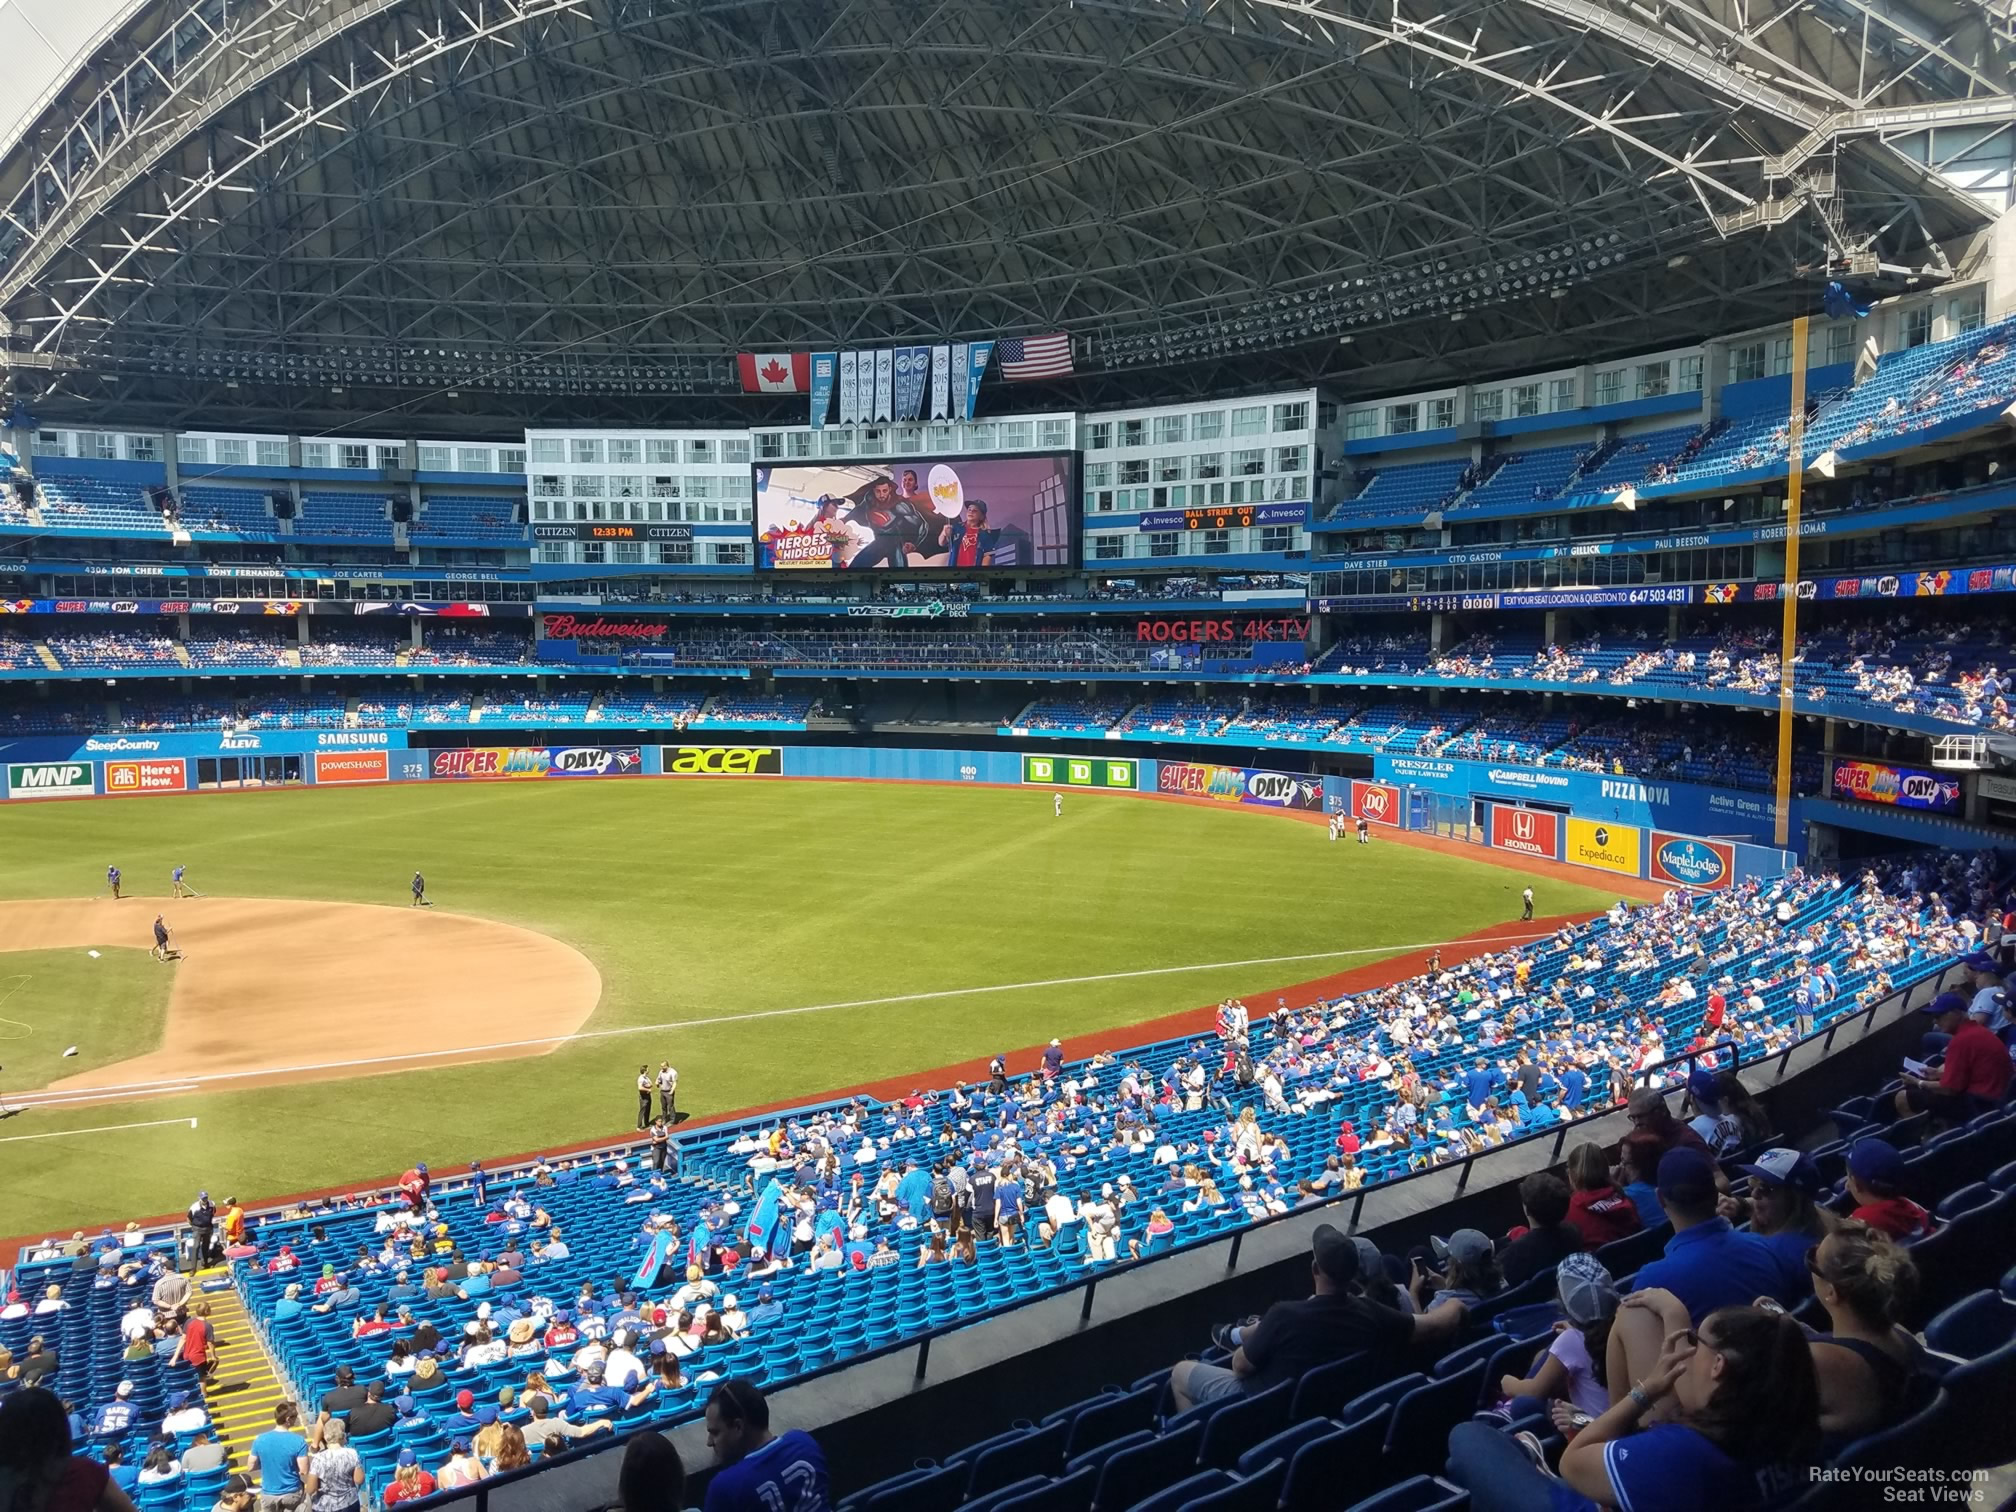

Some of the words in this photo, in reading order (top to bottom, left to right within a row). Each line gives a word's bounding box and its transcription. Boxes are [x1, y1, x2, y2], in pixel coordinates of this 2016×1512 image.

[878, 376, 890, 386] 1991
[934, 373, 948, 384] 2015
[1185, 510, 1204, 518] BALL
[1207, 508, 1233, 516] STRIKE
[1237, 507, 1254, 515] OUT
[1271, 508, 1305, 517] Invesco
[1153, 516, 1183, 525] Invesco
[1190, 518, 1198, 529] 0
[1216, 517, 1224, 528] 0
[1242, 515, 1250, 526] 0
[534, 527, 576, 537] CITIZEN
[593, 527, 616, 537] 12:33
[618, 527, 633, 537] PM
[649, 528, 690, 538] CITIZEN
[1761, 527, 1793, 539] ROBERTO
[1796, 522, 1826, 536] ALOMAR
[776, 533, 827, 550] HEROES
[1655, 540, 1672, 549] PAUL
[1675, 536, 1709, 547] BEESTON
[783, 545, 833, 560] HIDEOUT
[1571, 545, 1600, 555] GILLICK
[1366, 560, 1388, 568] STIEB
[1449, 555, 1466, 563] CITO
[1470, 553, 1501, 562] GASTON
[85, 567, 107, 575] 4306
[111, 567, 131, 575] TOM
[134, 567, 163, 575] CHEEK
[236, 569, 285, 577] FERNANDEZ
[1503, 596, 1517, 605] TEXT
[1517, 596, 1534, 605] YOUR
[1534, 595, 1549, 604] SEAT
[1549, 594, 1578, 604] LOCATION
[1585, 592, 1617, 604] QUESTION
[1617, 592, 1627, 601] TO
[1629, 590, 1648, 602] 647
[1650, 590, 1665, 601] 503
[1666, 589, 1685, 600] 4131
[56, 601, 87, 613] SUPER
[115, 602, 136, 612] DAY!
[160, 602, 189, 613] SUPER
[217, 602, 237, 612] DAY!
[848, 605, 924, 618] WESTJET
[543, 615, 668, 638] Budweiser
[1137, 620, 1234, 641] ROGERS
[1243, 619, 1274, 641] 4K
[1277, 619, 1312, 641] TV
[86, 738, 160, 751] SleepCountry
[219, 736, 262, 749] ALEVE
[318, 732, 388, 745] SAMSUNG
[434, 751, 499, 775] SUPER
[503, 748, 551, 773] JAYS
[564, 750, 610, 771] DAY!
[672, 747, 772, 773] acer
[1391, 759, 1455, 772] PRESZLER
[140, 765, 180, 776] Here's
[402, 764, 422, 773] 375
[960, 766, 976, 775] 400
[1031, 762, 1051, 779] TD
[1071, 764, 1089, 781] TD
[1109, 766, 1128, 783] TD
[1395, 768, 1415, 777] INJURY
[1417, 770, 1448, 779] LAWYERS
[21, 766, 82, 787] MNP
[141, 776, 173, 786] How.
[1160, 764, 1204, 791] SUPER
[1207, 766, 1246, 796] JAYS
[1254, 776, 1293, 798] DAY!
[1495, 769, 1536, 783] CAMPBELL
[1536, 774, 1568, 786] MOVING
[1834, 767, 1870, 788] SUPER
[1907, 778, 1936, 797] DAY!
[1602, 780, 1636, 801] PIZZA
[1639, 784, 1670, 806] NOVA
[1328, 795, 1343, 807] 375
[1366, 793, 1386, 814] DQ
[1709, 794, 1735, 808] Active
[1737, 798, 1760, 812] Green
[1767, 803, 1787, 817] Ross
[1504, 838, 1543, 854] HONDA
[1579, 845, 1625, 865] Expedia.ca
[1679, 866, 1701, 878] FARMS
[975, 1175, 992, 1186] STAFF
[586, 1326, 606, 1340] 20
[101, 1415, 129, 1432] 55
